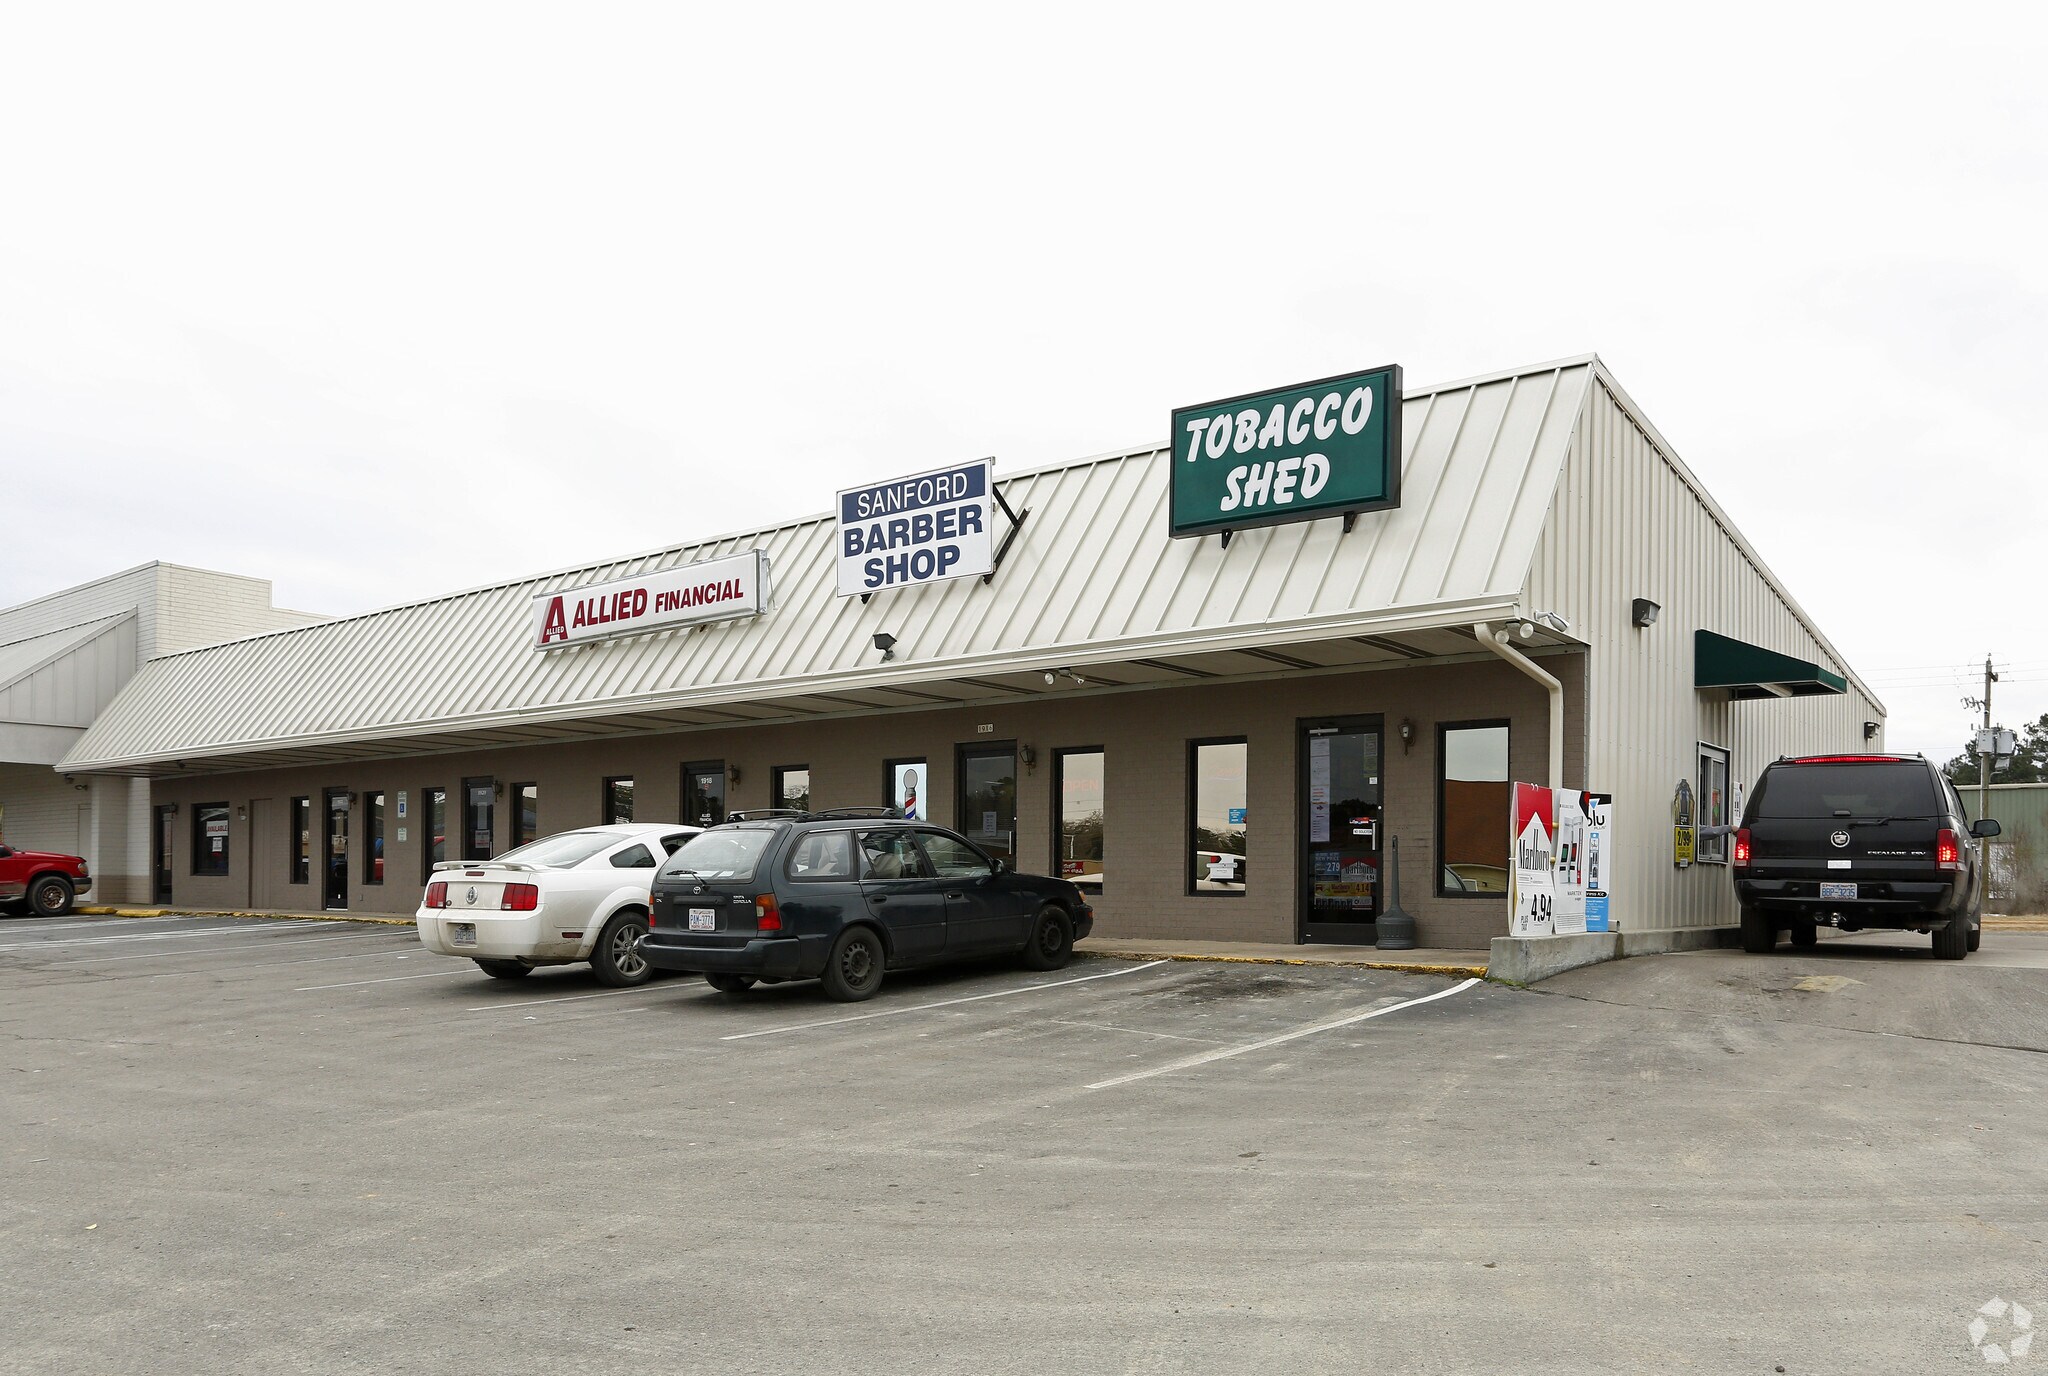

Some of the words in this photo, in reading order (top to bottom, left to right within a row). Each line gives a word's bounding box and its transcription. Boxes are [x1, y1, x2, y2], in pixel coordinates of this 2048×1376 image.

[1186, 385, 1373, 462] TOBACCO
[857, 472, 968, 518] SANFORD
[1220, 453, 1331, 512] SHED
[844, 504, 983, 558] BARBER
[864, 544, 960, 588] SHOP
[572, 588, 648, 629] ALLIED
[655, 578, 744, 613] FINANCIAL
[546, 626, 565, 635] ALLIED
[1518, 828, 1550, 871] Marlboro
[1531, 893, 1552, 922] 4.94
